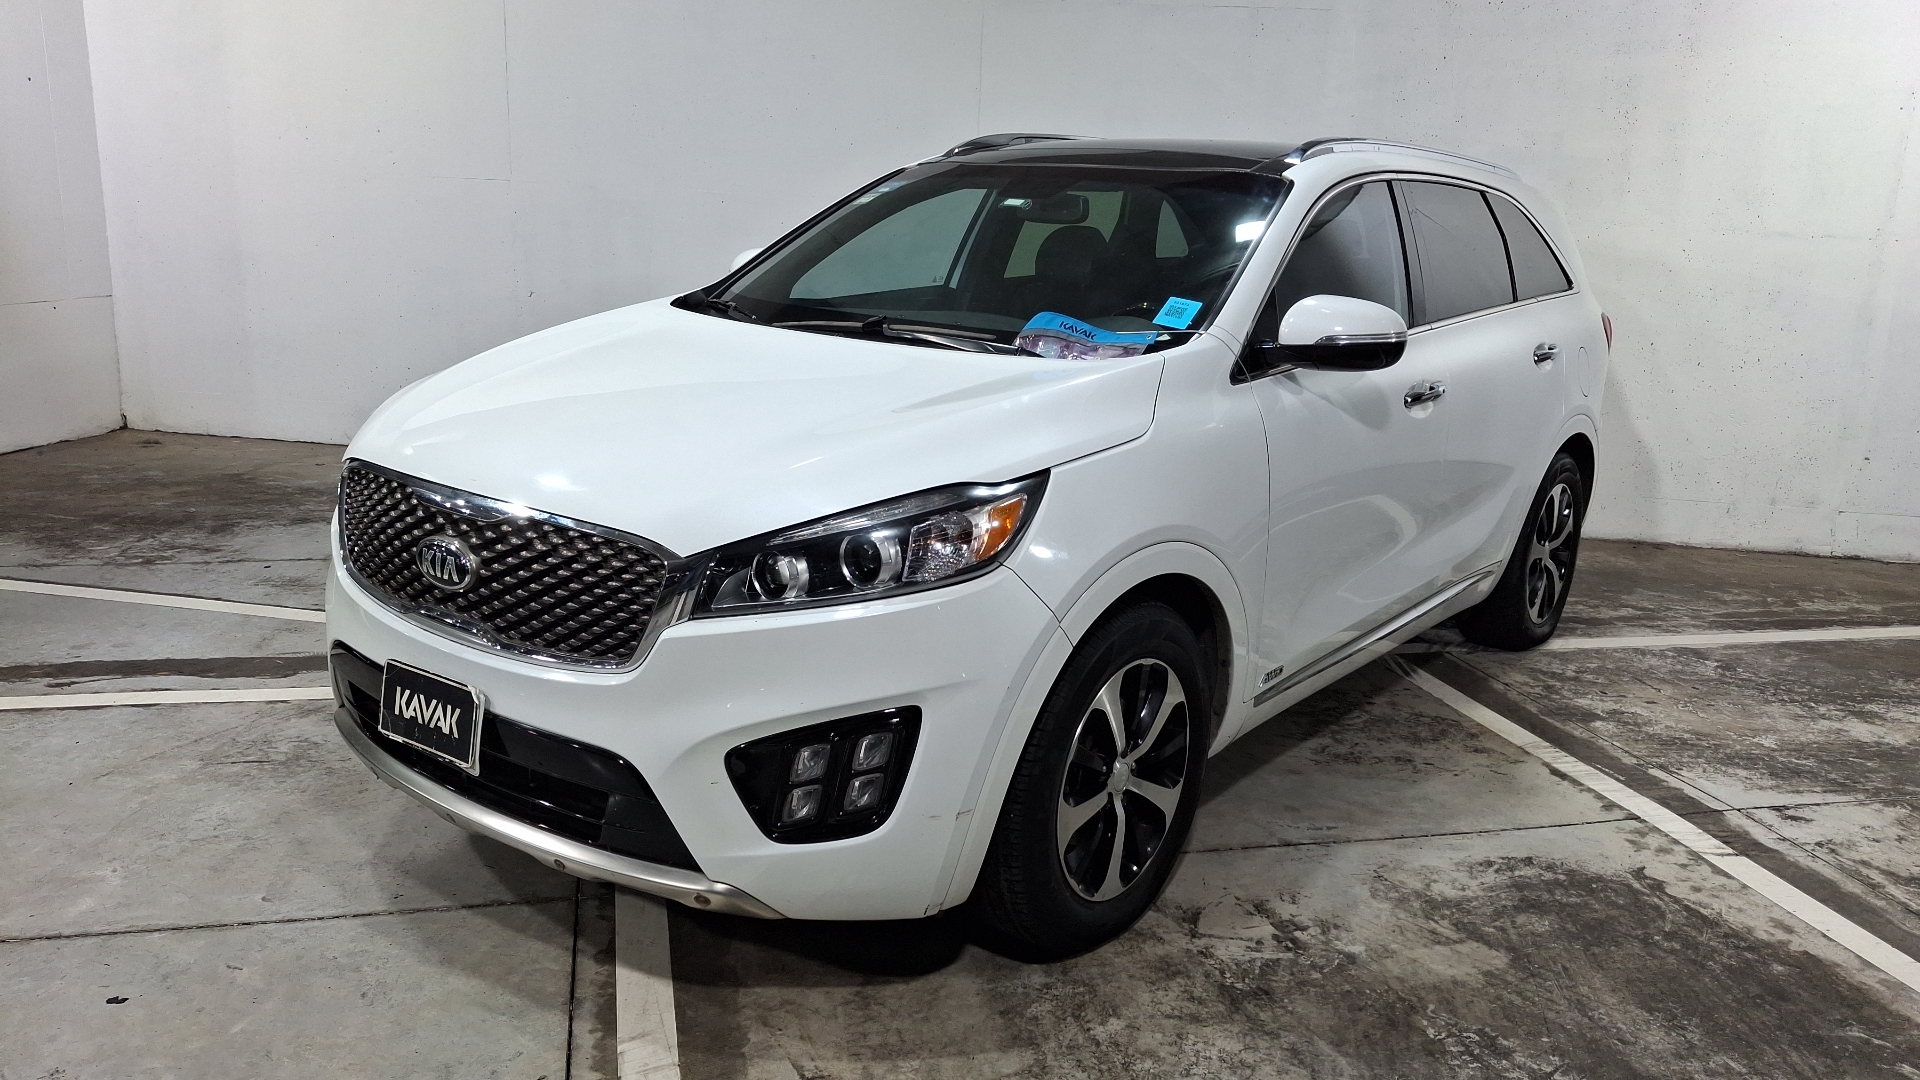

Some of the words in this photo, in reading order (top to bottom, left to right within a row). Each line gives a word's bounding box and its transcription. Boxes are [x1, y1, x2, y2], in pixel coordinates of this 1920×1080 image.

[1059, 321, 1097, 340] KAVAK
[422, 547, 459, 582] KIA
[394, 686, 461, 738] KAVAK
